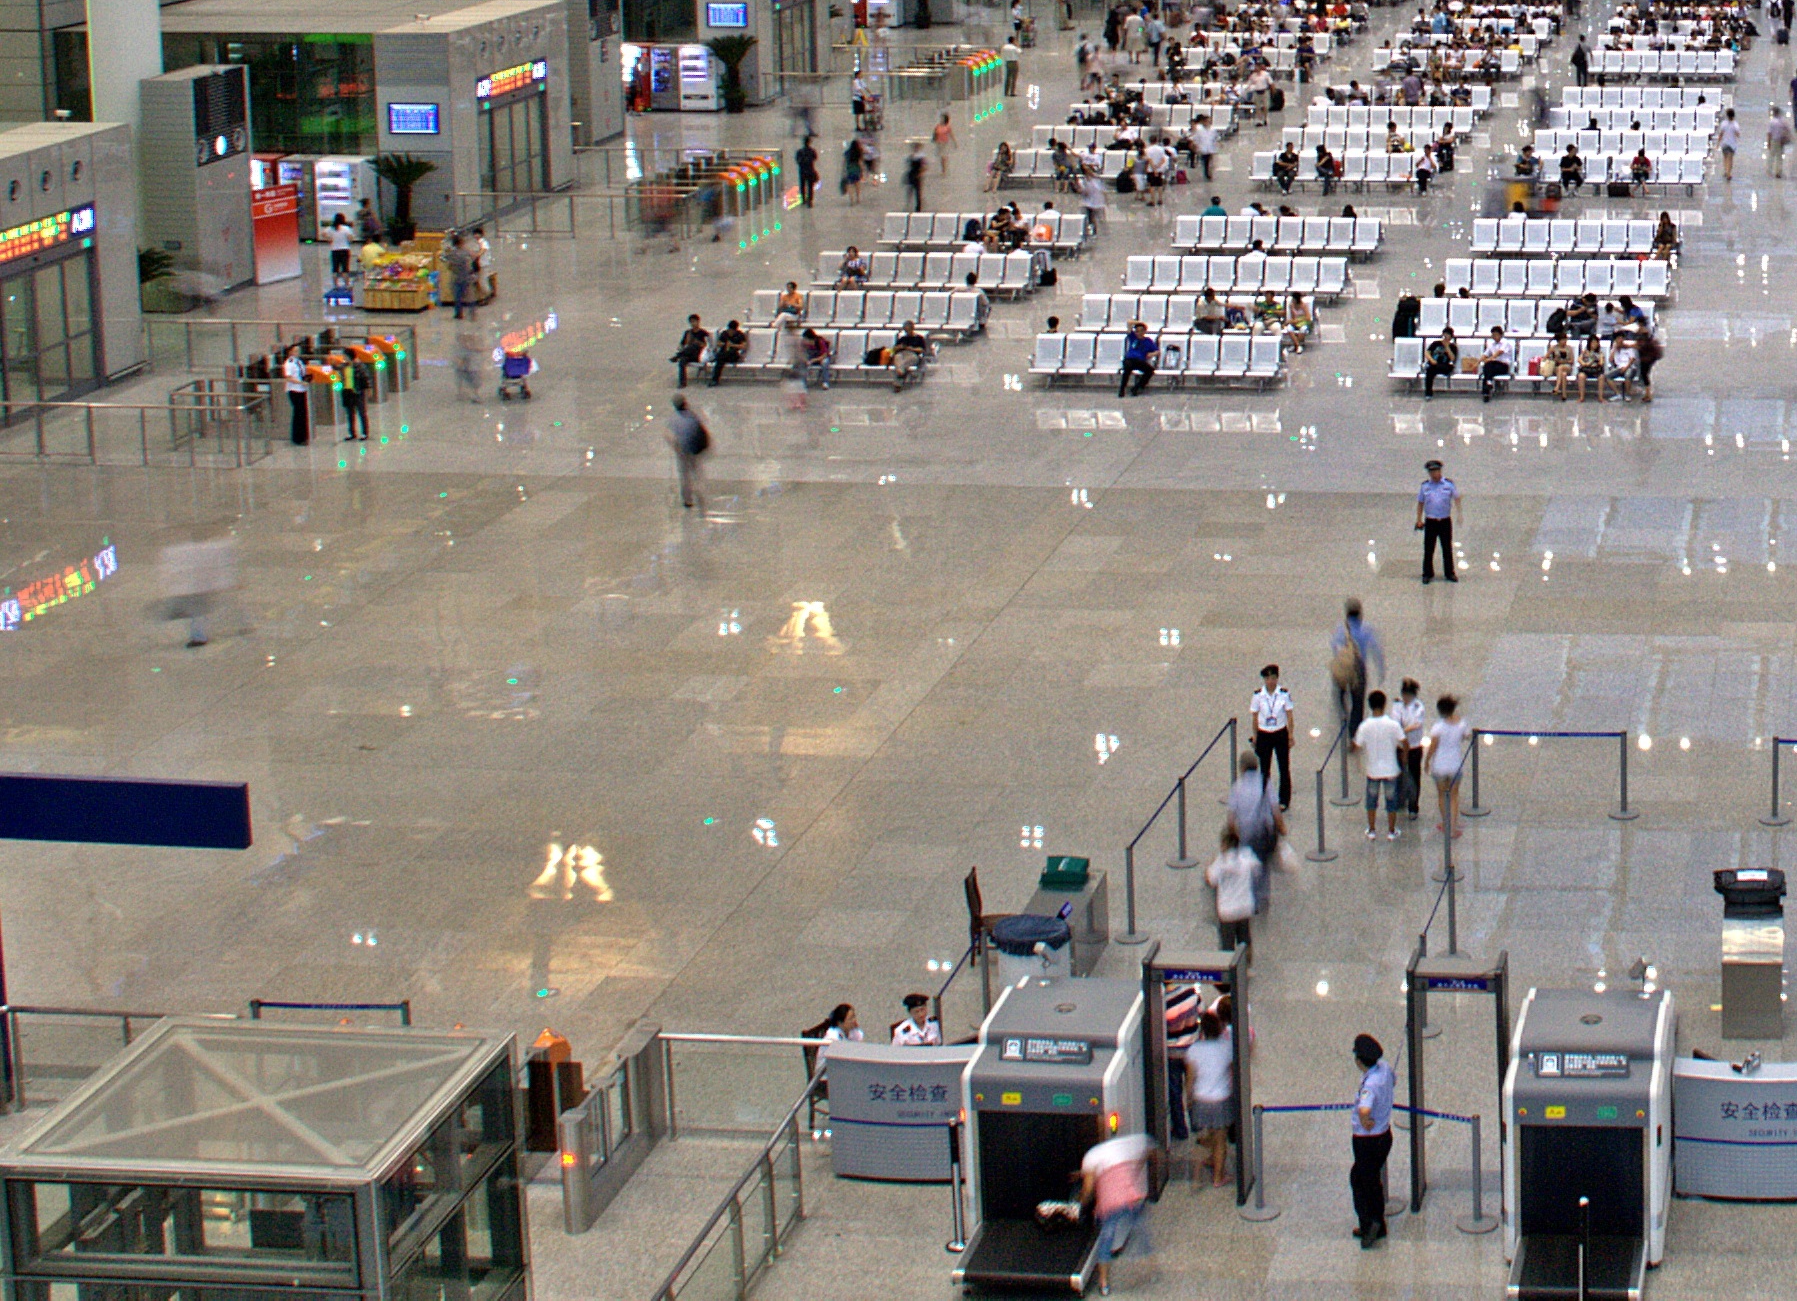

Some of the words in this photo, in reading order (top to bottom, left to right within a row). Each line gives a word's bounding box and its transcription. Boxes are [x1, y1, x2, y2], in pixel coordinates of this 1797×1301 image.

[868, 1083, 948, 1102] 安全检查
[1748, 1128, 1788, 1137] SECURITY
